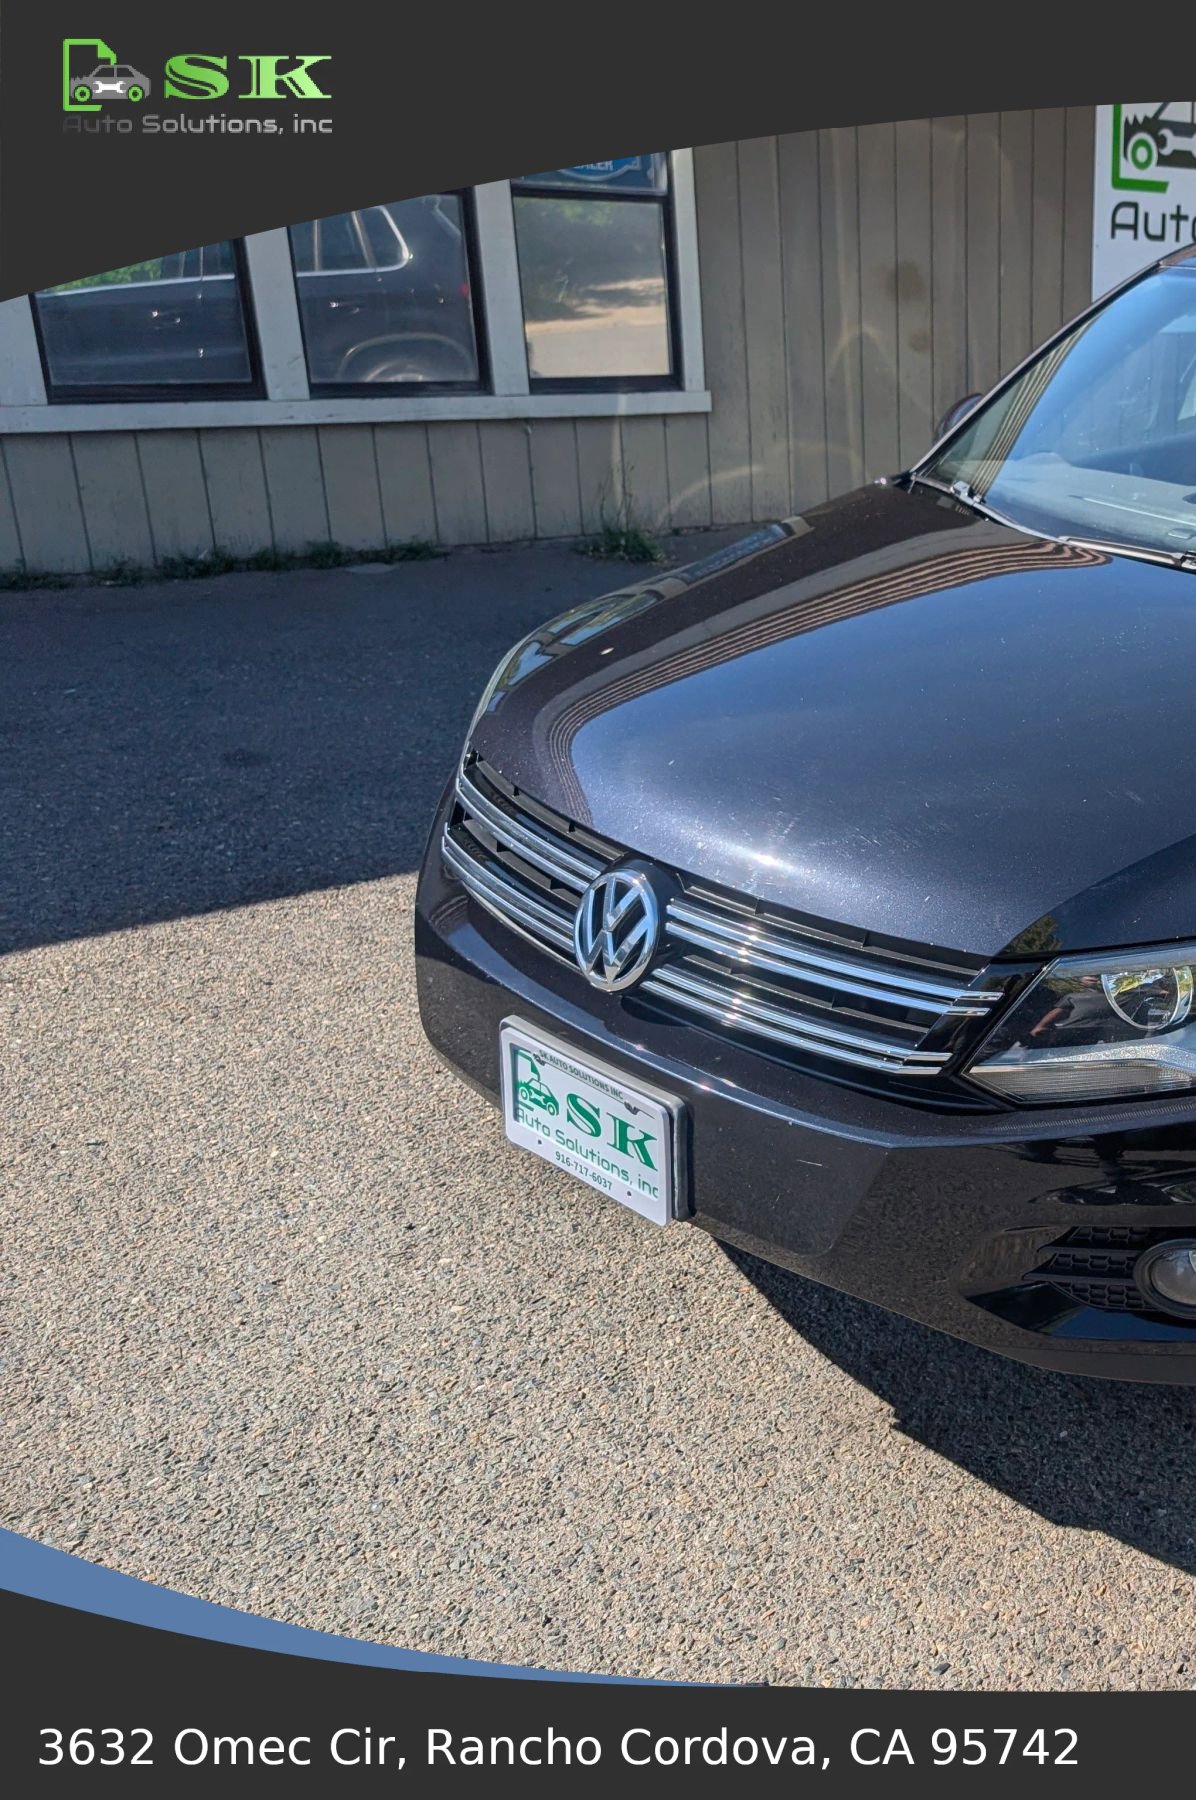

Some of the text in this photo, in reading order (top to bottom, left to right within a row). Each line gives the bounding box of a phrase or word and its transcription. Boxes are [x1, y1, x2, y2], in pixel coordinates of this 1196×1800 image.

[548, 1055, 568, 1070] AUTO
[568, 1065, 610, 1093] SOLUTIONS
[610, 1088, 624, 1100] INC
[517, 1107, 659, 1199] Auto Solutions, inc
[566, 1093, 658, 1172] SK
[555, 1151, 612, 1191] 916-717-6037
